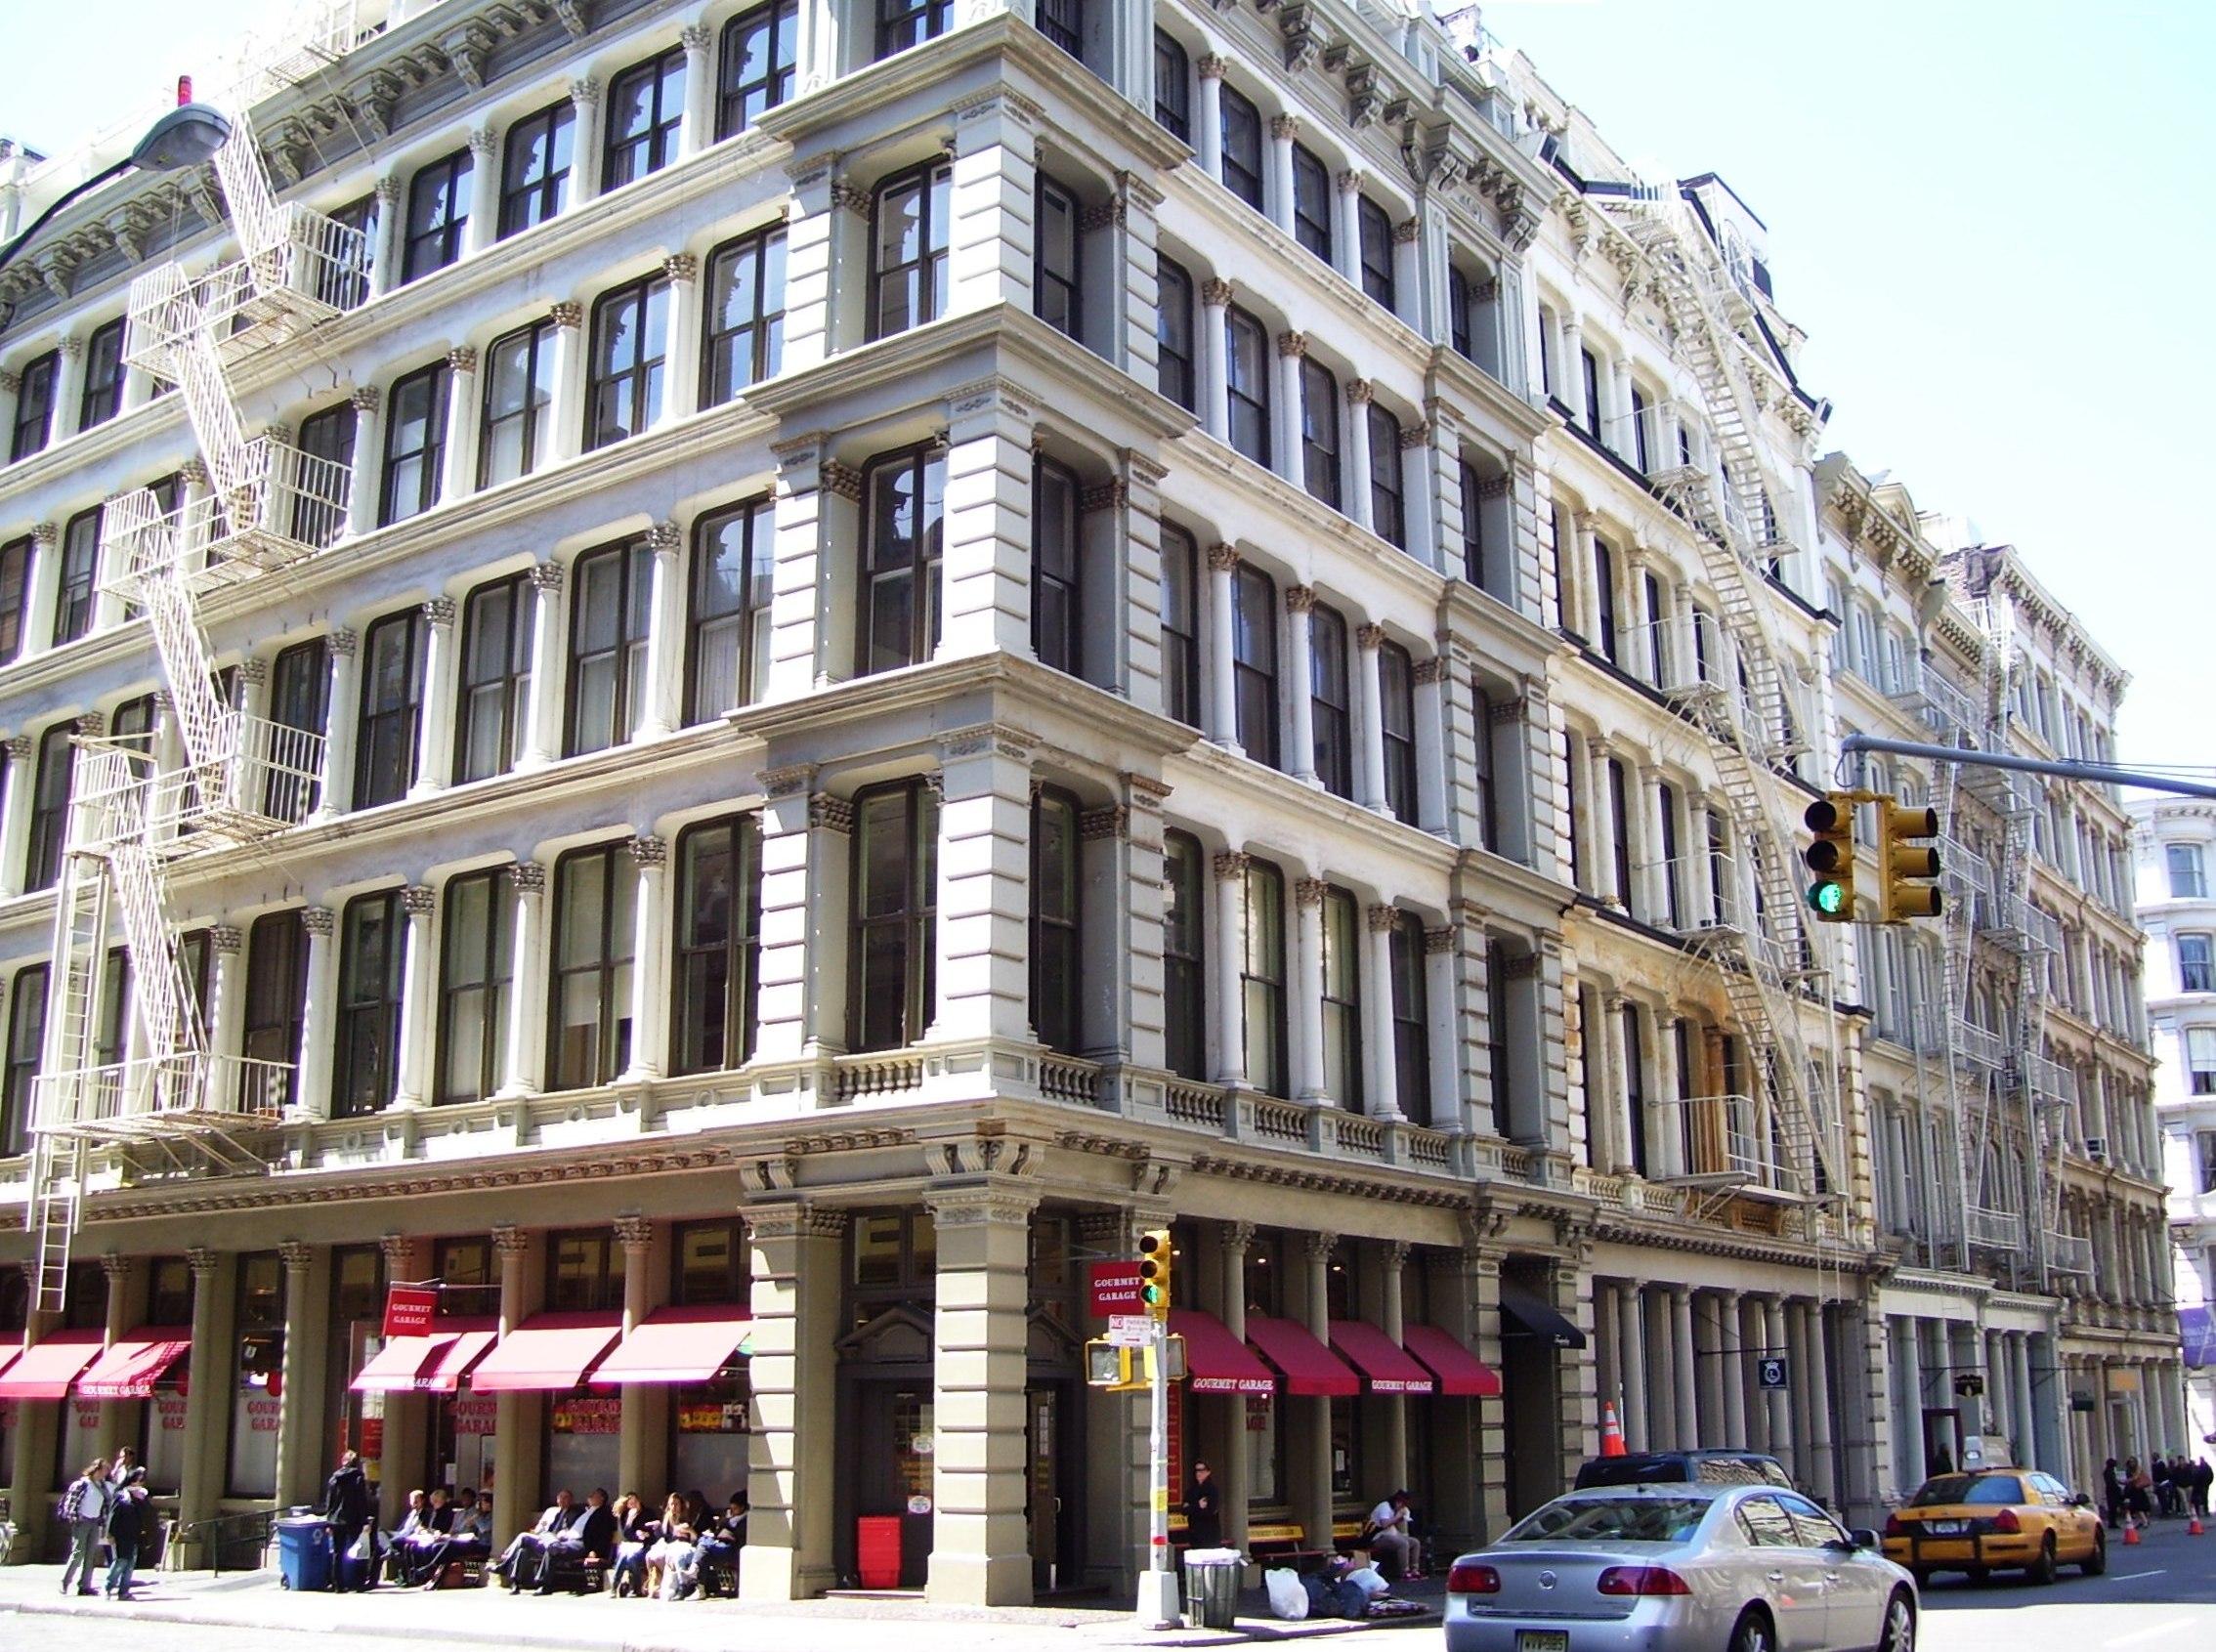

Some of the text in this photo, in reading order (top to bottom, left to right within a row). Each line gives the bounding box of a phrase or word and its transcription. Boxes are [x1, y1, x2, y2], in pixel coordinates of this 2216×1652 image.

[1094, 1277, 1140, 1287] GOURMET
[1098, 1291, 1136, 1300] GARAGE
[392, 1303, 432, 1313] GOURMET
[1111, 1317, 1124, 1328] NO
[1193, 1378, 1274, 1390] GOURMET GARAGE
[1372, 1379, 1432, 1391] GOURMET GARAGE
